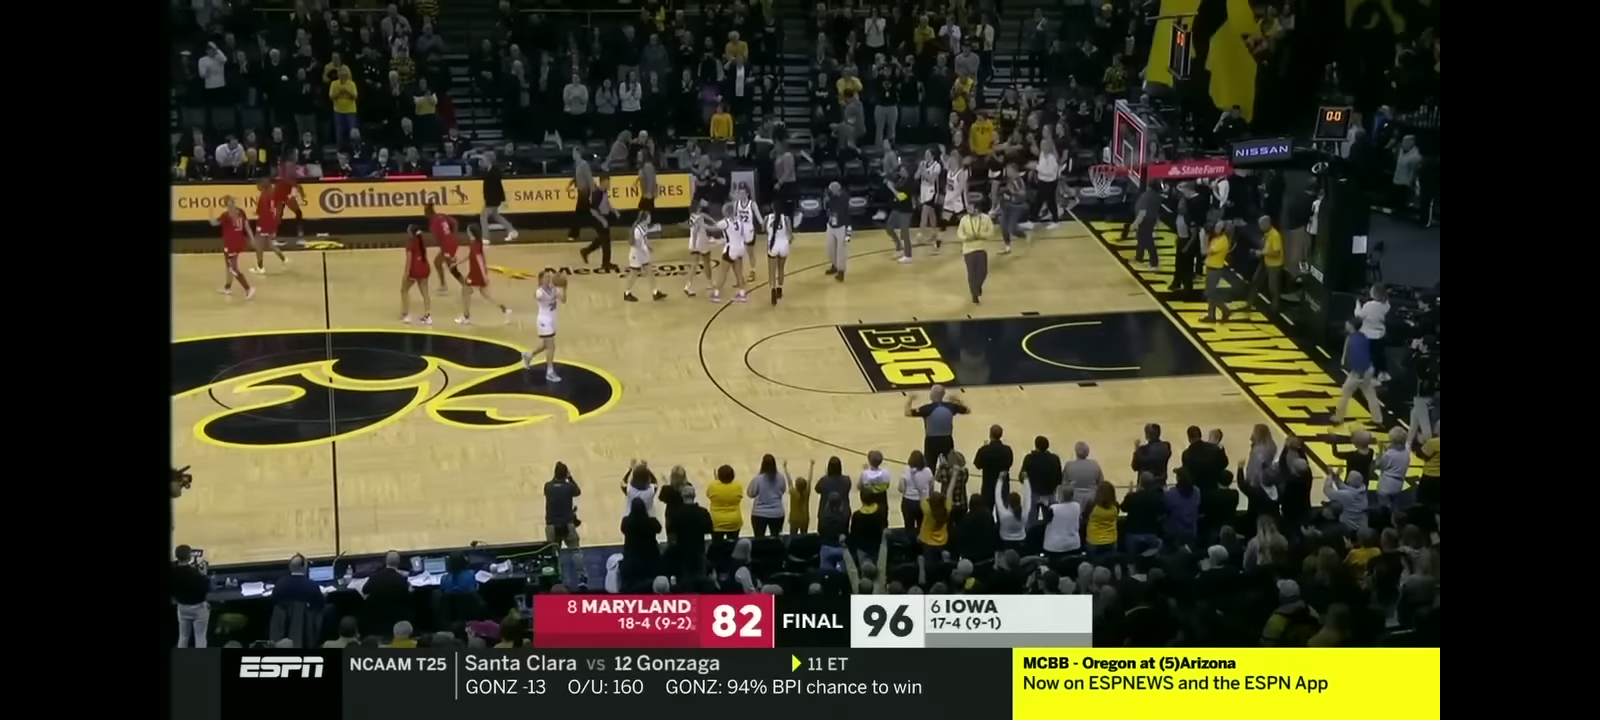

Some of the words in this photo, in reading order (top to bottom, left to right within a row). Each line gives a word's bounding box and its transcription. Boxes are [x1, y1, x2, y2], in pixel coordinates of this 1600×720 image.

[1235, 145, 1289, 157] NISSAN
[514, 189, 561, 201] SMART
[625, 187, 639, 197] IN
[659, 185, 684, 196] RES
[178, 196, 226, 209] CHOIC
[319, 187, 449, 214] Continental
